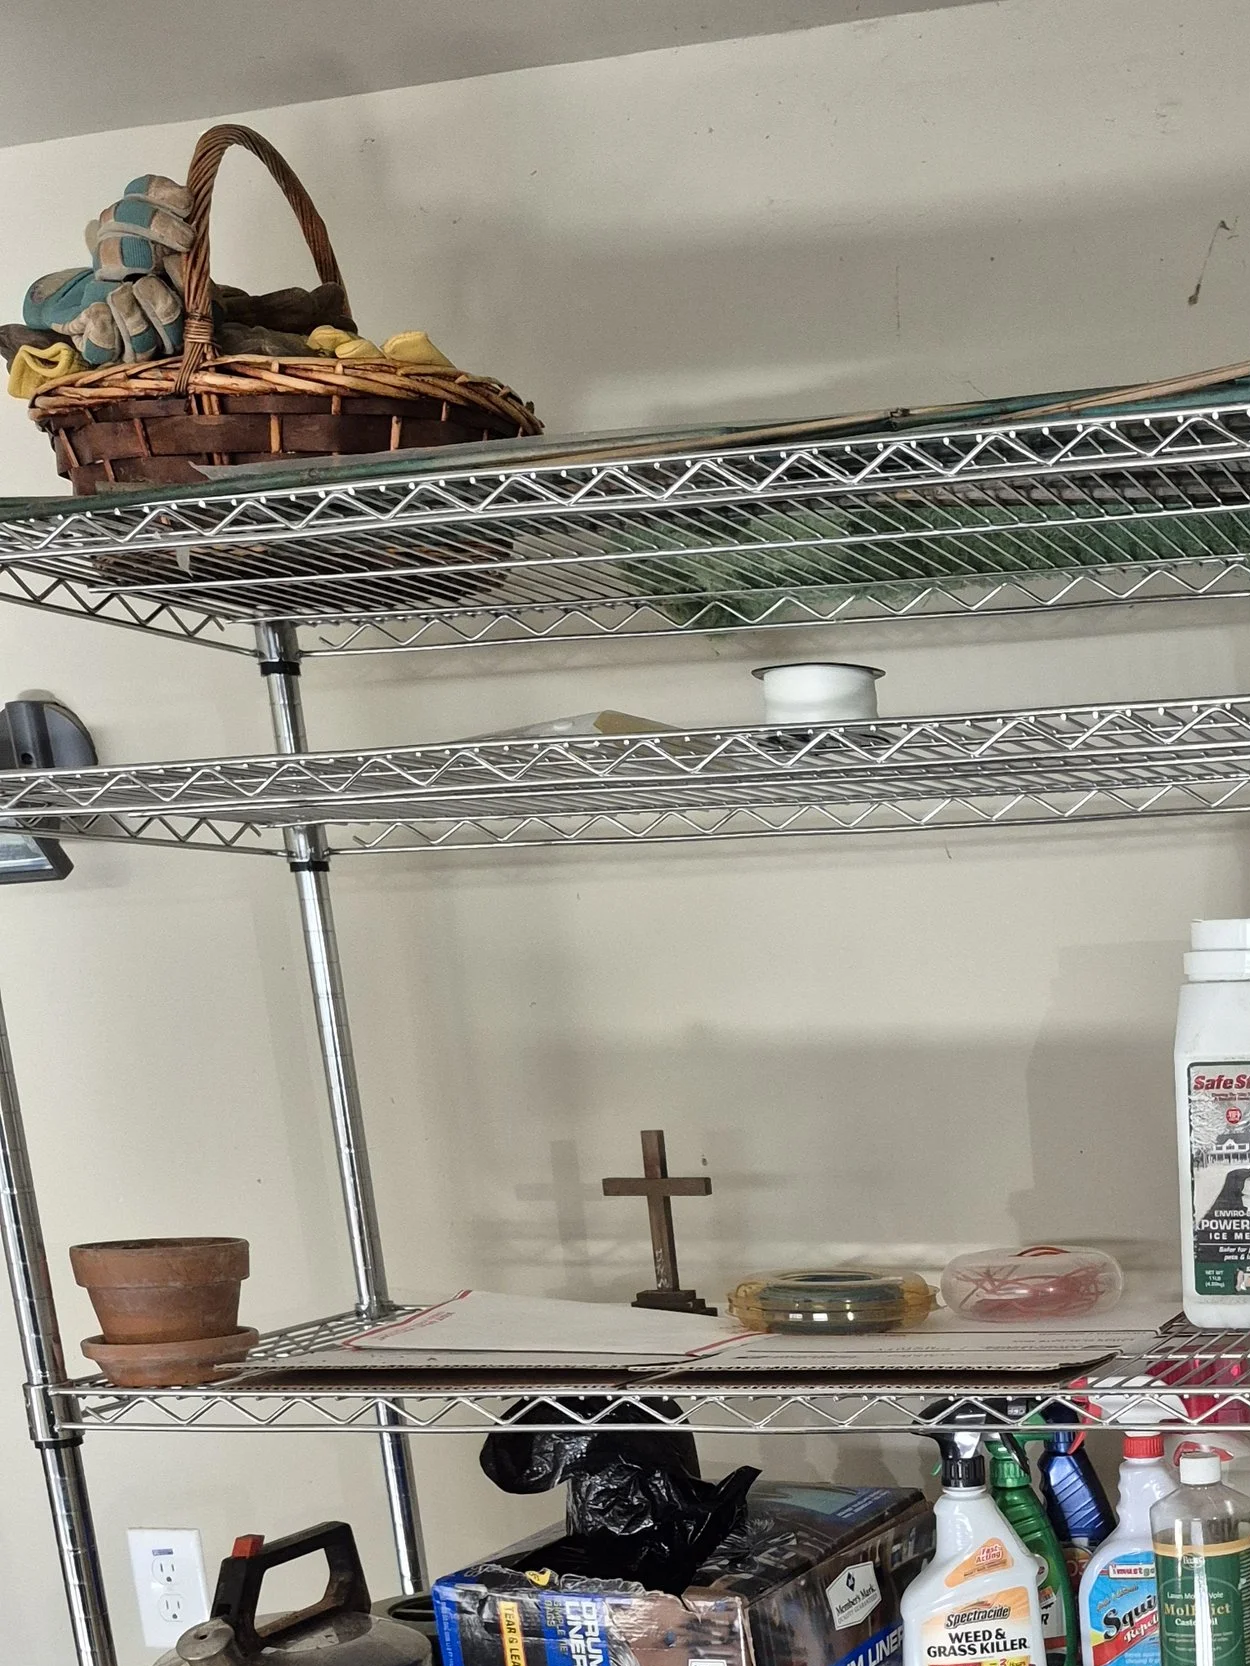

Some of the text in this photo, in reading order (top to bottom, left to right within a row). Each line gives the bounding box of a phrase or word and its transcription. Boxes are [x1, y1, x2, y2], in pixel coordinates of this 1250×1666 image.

[1201, 1219, 1250, 1231] POWER
[1209, 1232, 1228, 1240] ICE
[976, 1551, 1003, 1563] Acting
[835, 1583, 876, 1617] Member's Mark
[505, 1606, 517, 1634] TEAR
[945, 1606, 1011, 1628] Spectracide
[949, 1628, 1006, 1644] WEED &
[927, 1637, 1028, 1658] GRASS KILLER
